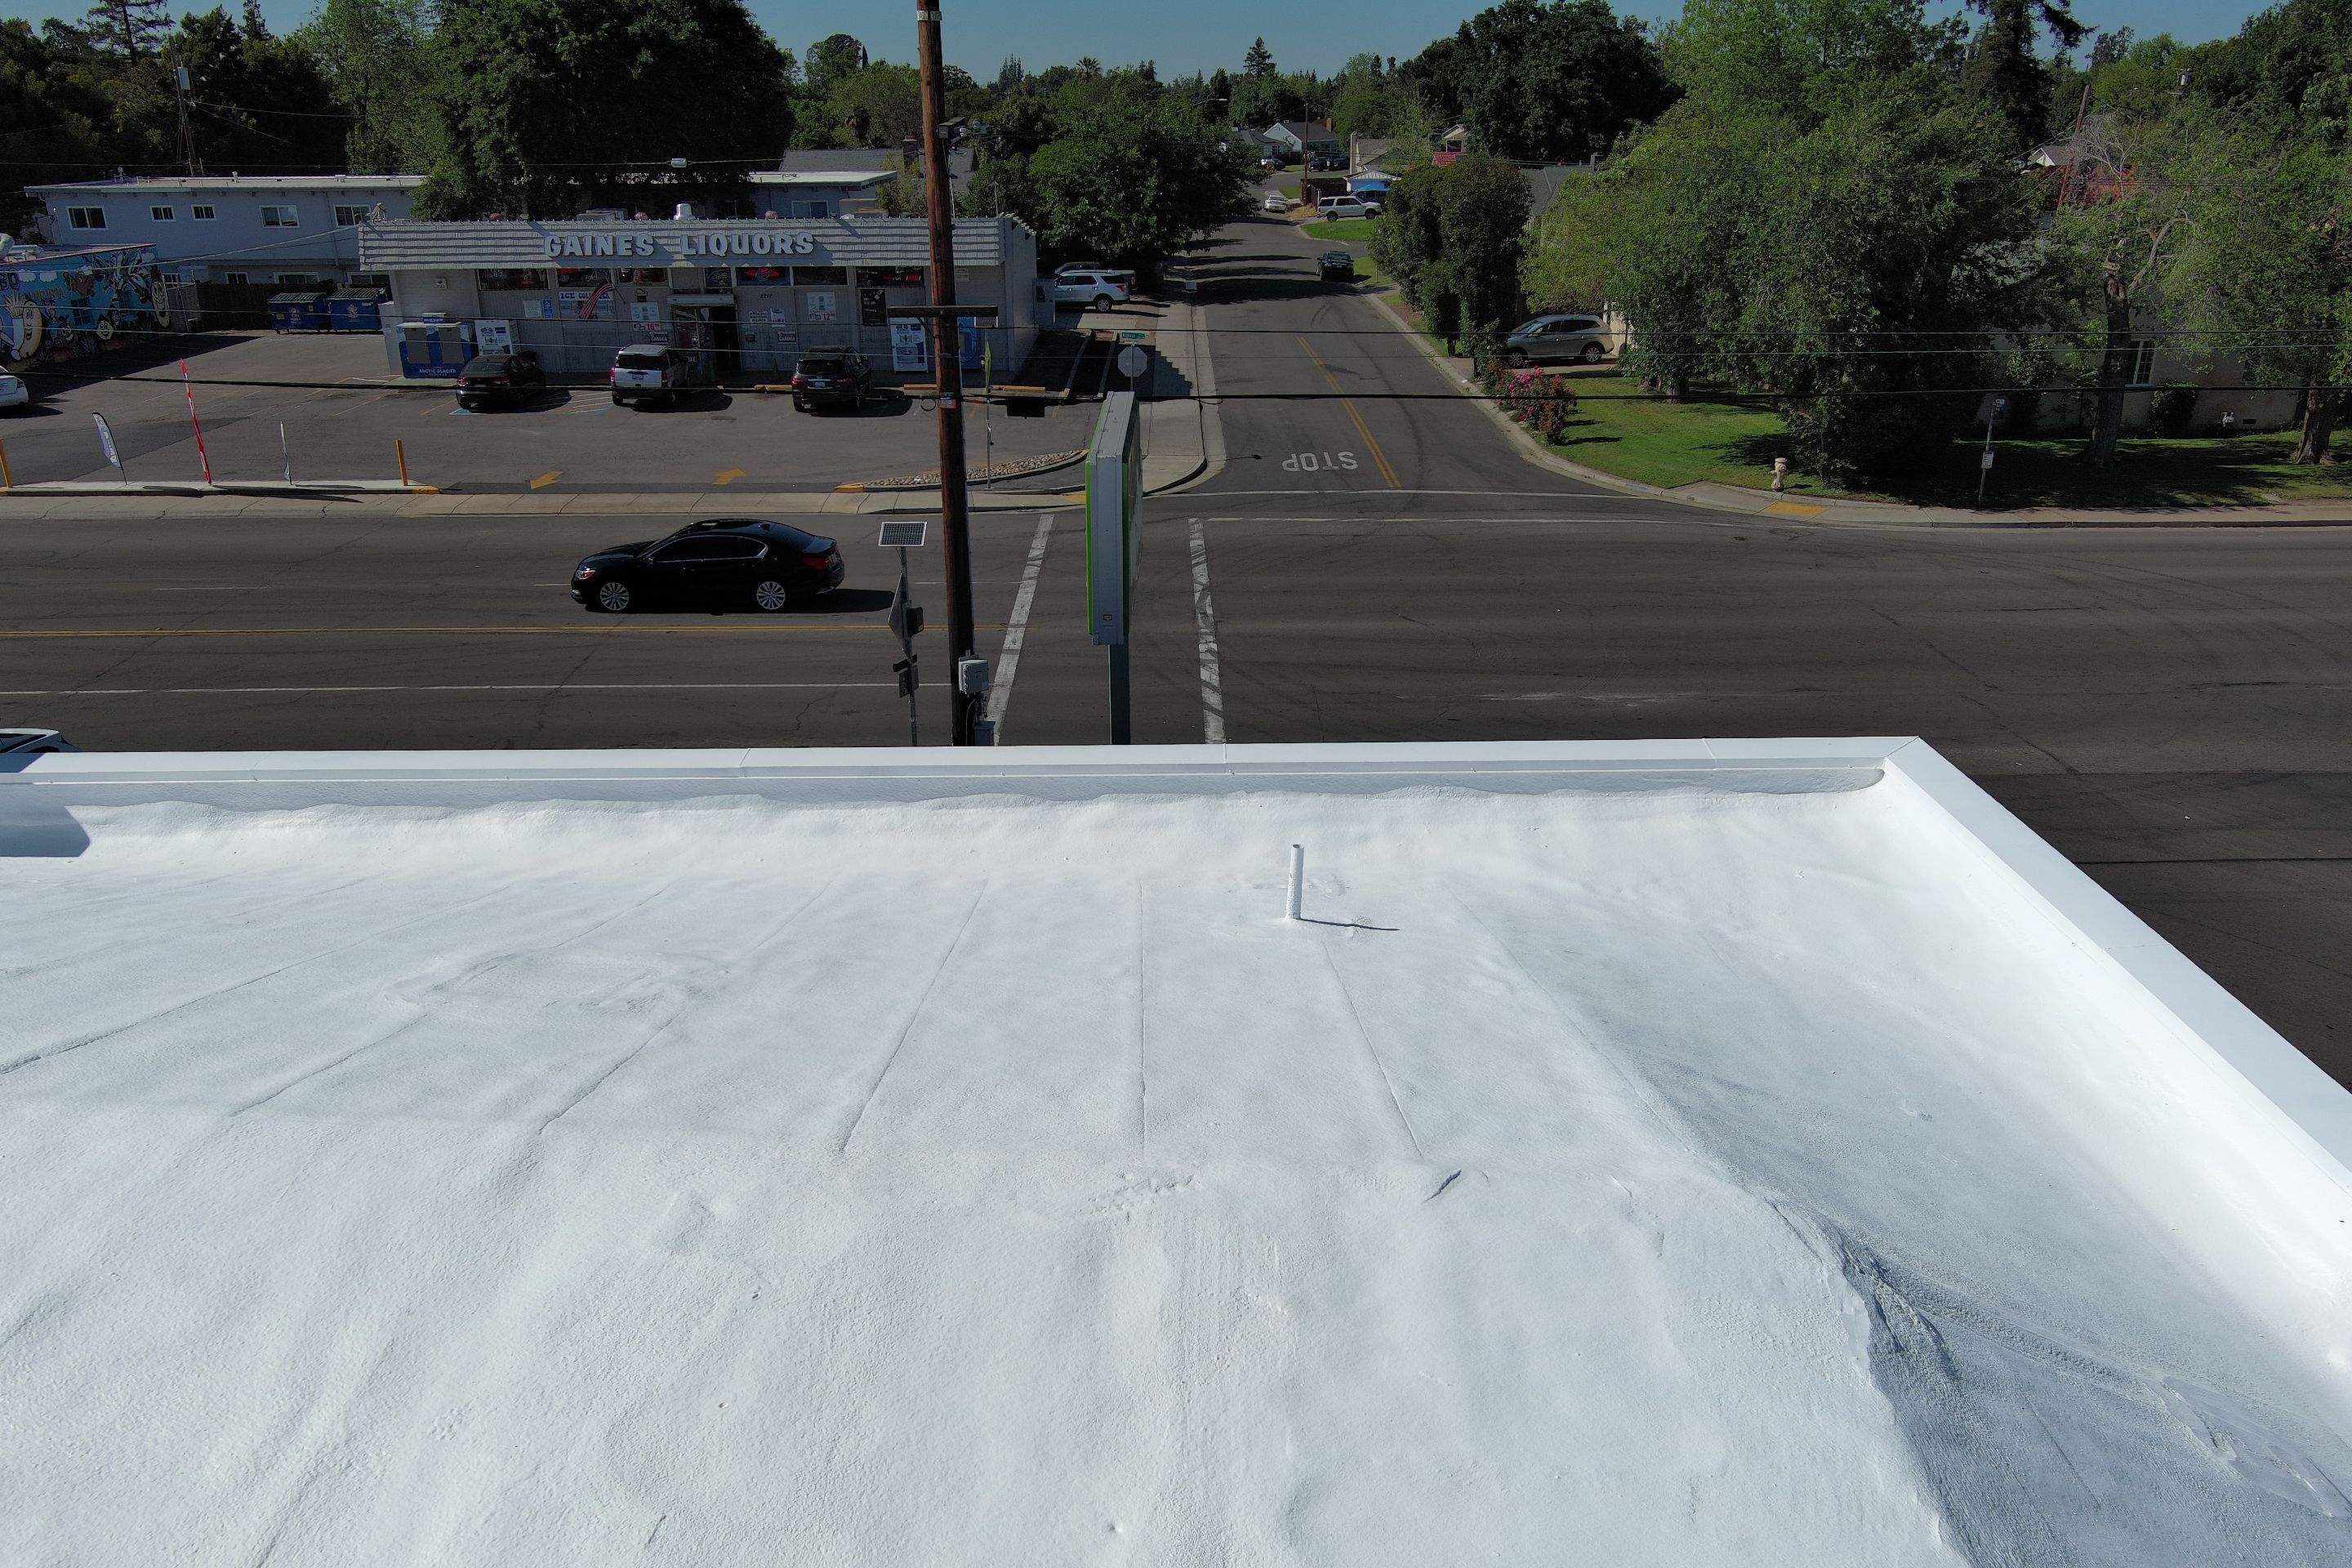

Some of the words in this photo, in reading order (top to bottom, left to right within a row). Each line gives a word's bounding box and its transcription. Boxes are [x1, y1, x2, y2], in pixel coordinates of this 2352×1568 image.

[544, 233, 654, 257] GAINES
[679, 231, 814, 256] LIQUORS
[1281, 451, 1359, 472] STOP
